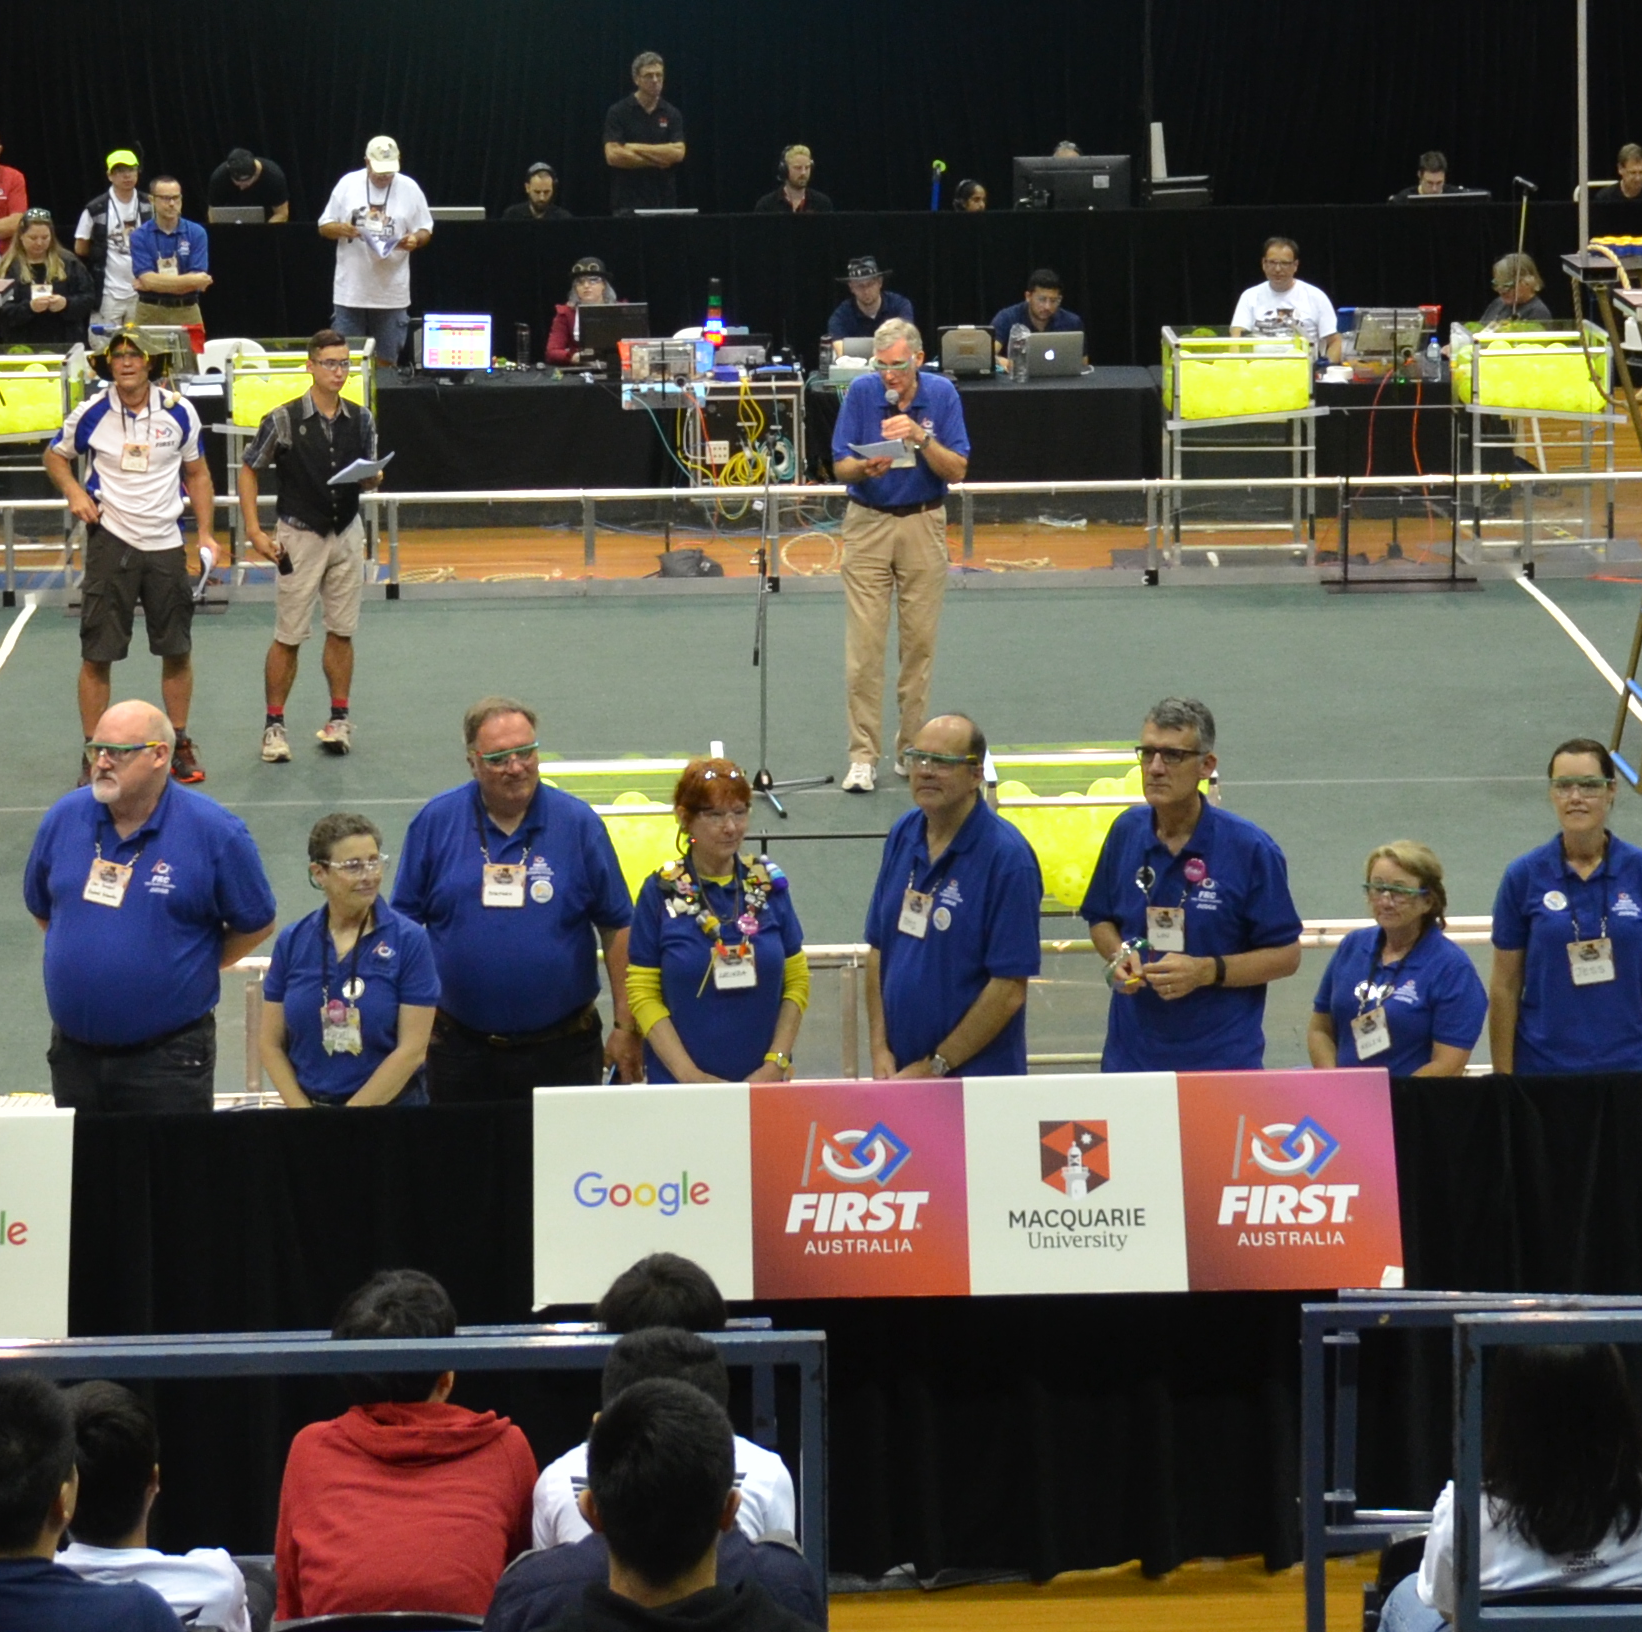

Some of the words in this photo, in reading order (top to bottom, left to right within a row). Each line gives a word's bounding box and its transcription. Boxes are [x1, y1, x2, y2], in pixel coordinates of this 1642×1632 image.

[573, 1170, 711, 1216] Google
[1217, 1184, 1360, 1226] FIRST
[785, 1190, 930, 1234] FIRST
[1008, 1207, 1147, 1231] MACQUARIE
[804, 1238, 914, 1256] AUSTRALIA
[1027, 1231, 1129, 1252] University
[1237, 1230, 1346, 1247] AUSTRALIA
